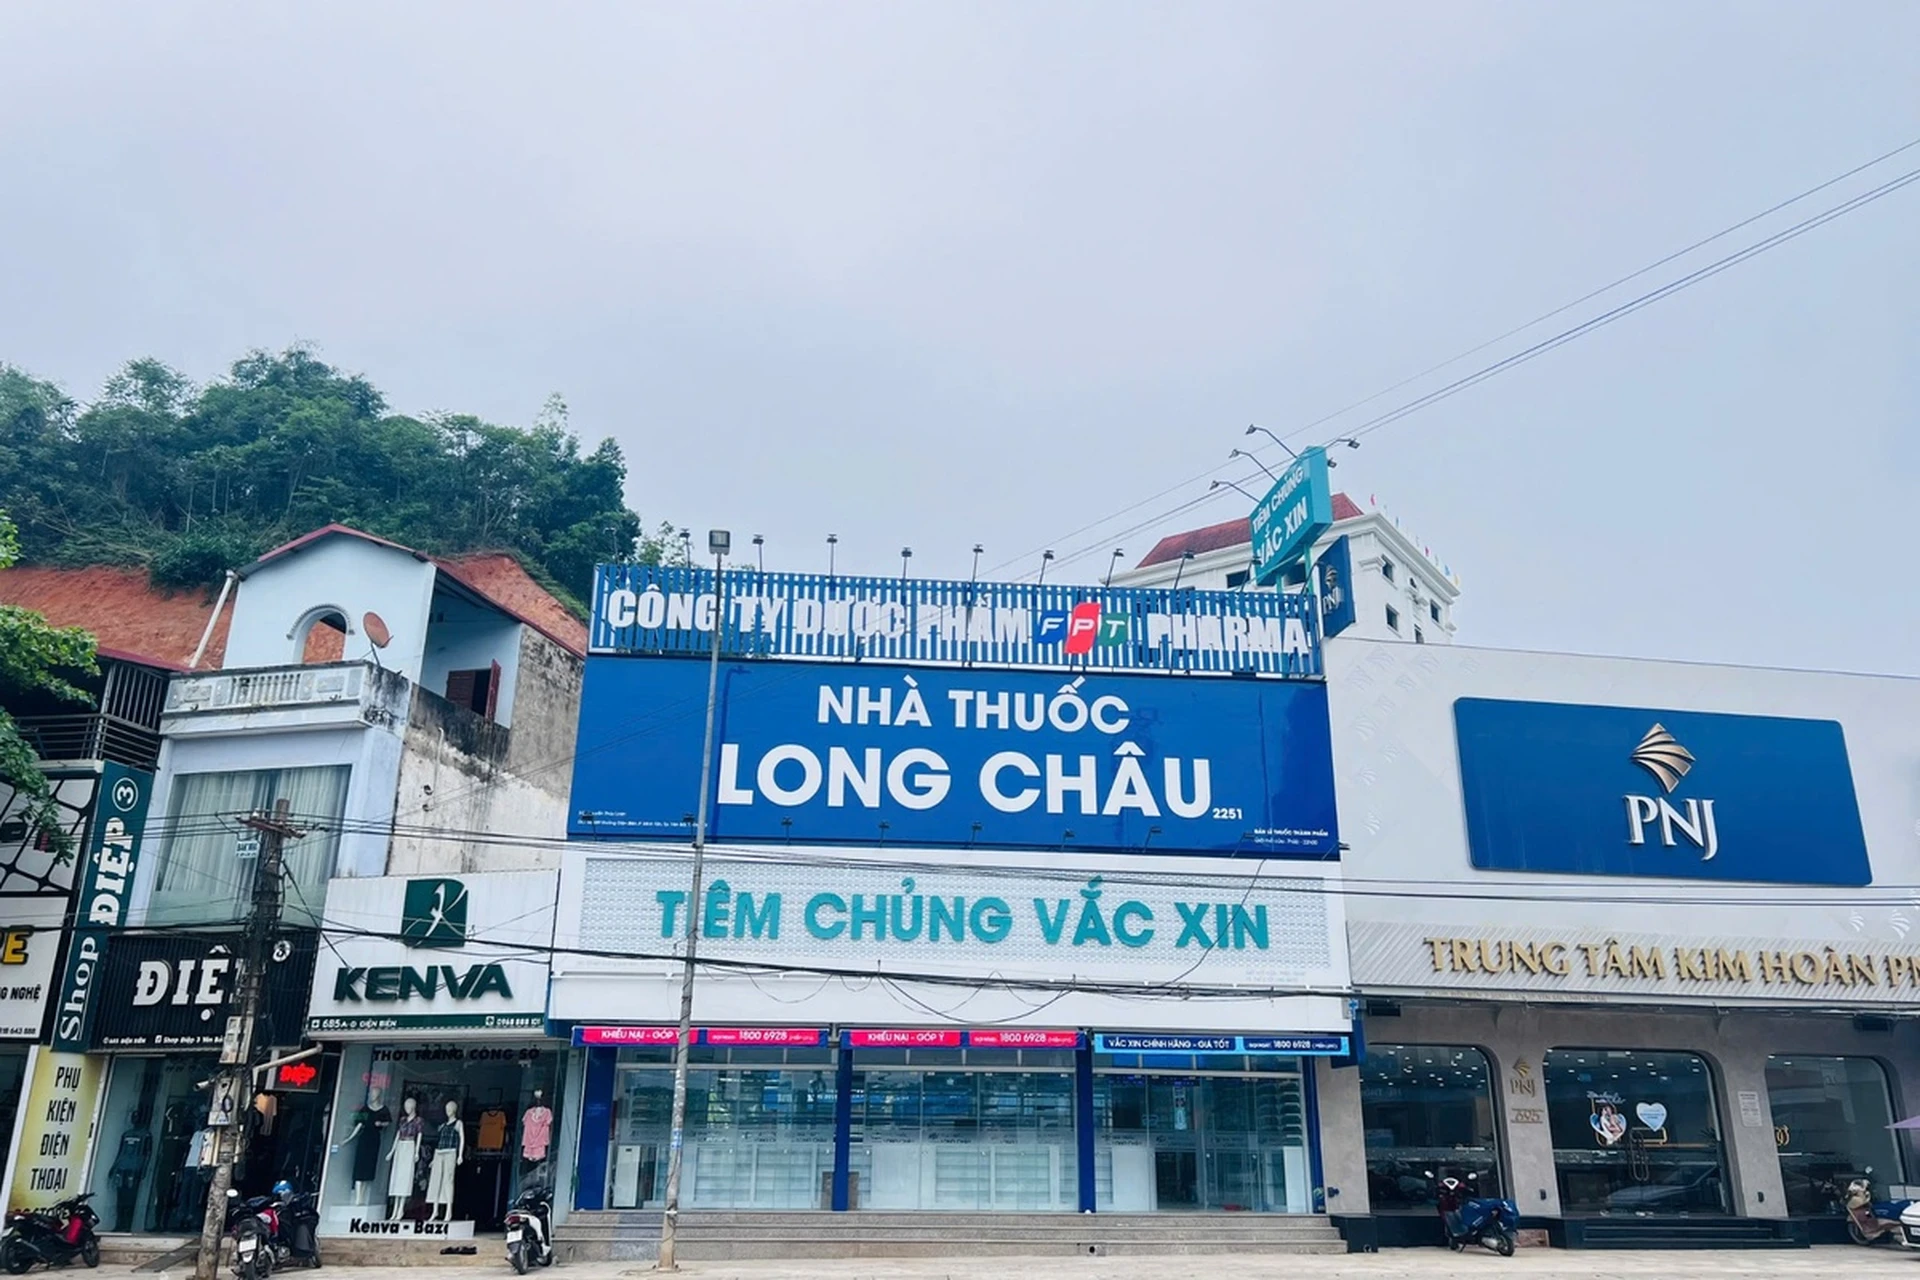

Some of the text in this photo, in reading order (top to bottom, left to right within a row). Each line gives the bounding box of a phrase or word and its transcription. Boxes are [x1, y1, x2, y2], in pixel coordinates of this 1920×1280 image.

[1252, 466, 1304, 534] TIÊM CHỦNG
[1257, 496, 1308, 568] VẮC XIN
[608, 584, 717, 631] CÔNG
[735, 595, 784, 632] TY
[796, 595, 905, 643] DƯỢC
[917, 594, 1029, 643] PHẨM
[1147, 613, 1309, 653] PHARMA
[817, 675, 1130, 734] NHÀ THUỐC
[717, 741, 1243, 820] LONG CHÂU 2251
[1624, 794, 1718, 861] PNJ
[804, 877, 1013, 943] CHỦNG
[1033, 875, 1154, 948] VẮC
[1174, 901, 1270, 949] XIN
[60, 937, 99, 1040] Shop
[89, 817, 135, 926] ĐIỆP
[0, 926, 33, 965] E
[1425, 937, 1570, 976] TRUNG
[1579, 938, 1666, 979] TÂM
[1675, 947, 1752, 982] KIM
[1760, 946, 1881, 987] HOÀN
[10, 985, 41, 1002] NGHỆ
[133, 944, 243, 1021] ĐIỆ
[333, 965, 513, 1001] KENVA
[652, 1029, 673, 1039] GÓP
[740, 1031, 761, 1040] 1800
[763, 1031, 787, 1040] 6928
[894, 1033, 909, 1044] NẠI
[916, 1031, 937, 1041] GÓP
[1000, 1032, 1021, 1042] 1800
[1023, 1033, 1046, 1042] 6928
[1108, 1037, 1126, 1047] VẮC
[1128, 1039, 1141, 1047] XIN
[1214, 1038, 1229, 1048] TỐT
[1273, 1040, 1291, 1048] 1800
[55, 1066, 81, 1098] PHỤ
[1510, 1079, 1535, 1098] PNJ
[46, 1100, 76, 1126] KIỆN
[40, 1132, 69, 1160] ĐIỆN
[30, 1168, 67, 1194] THOẠI
[350, 1218, 400, 1234] Kenva
